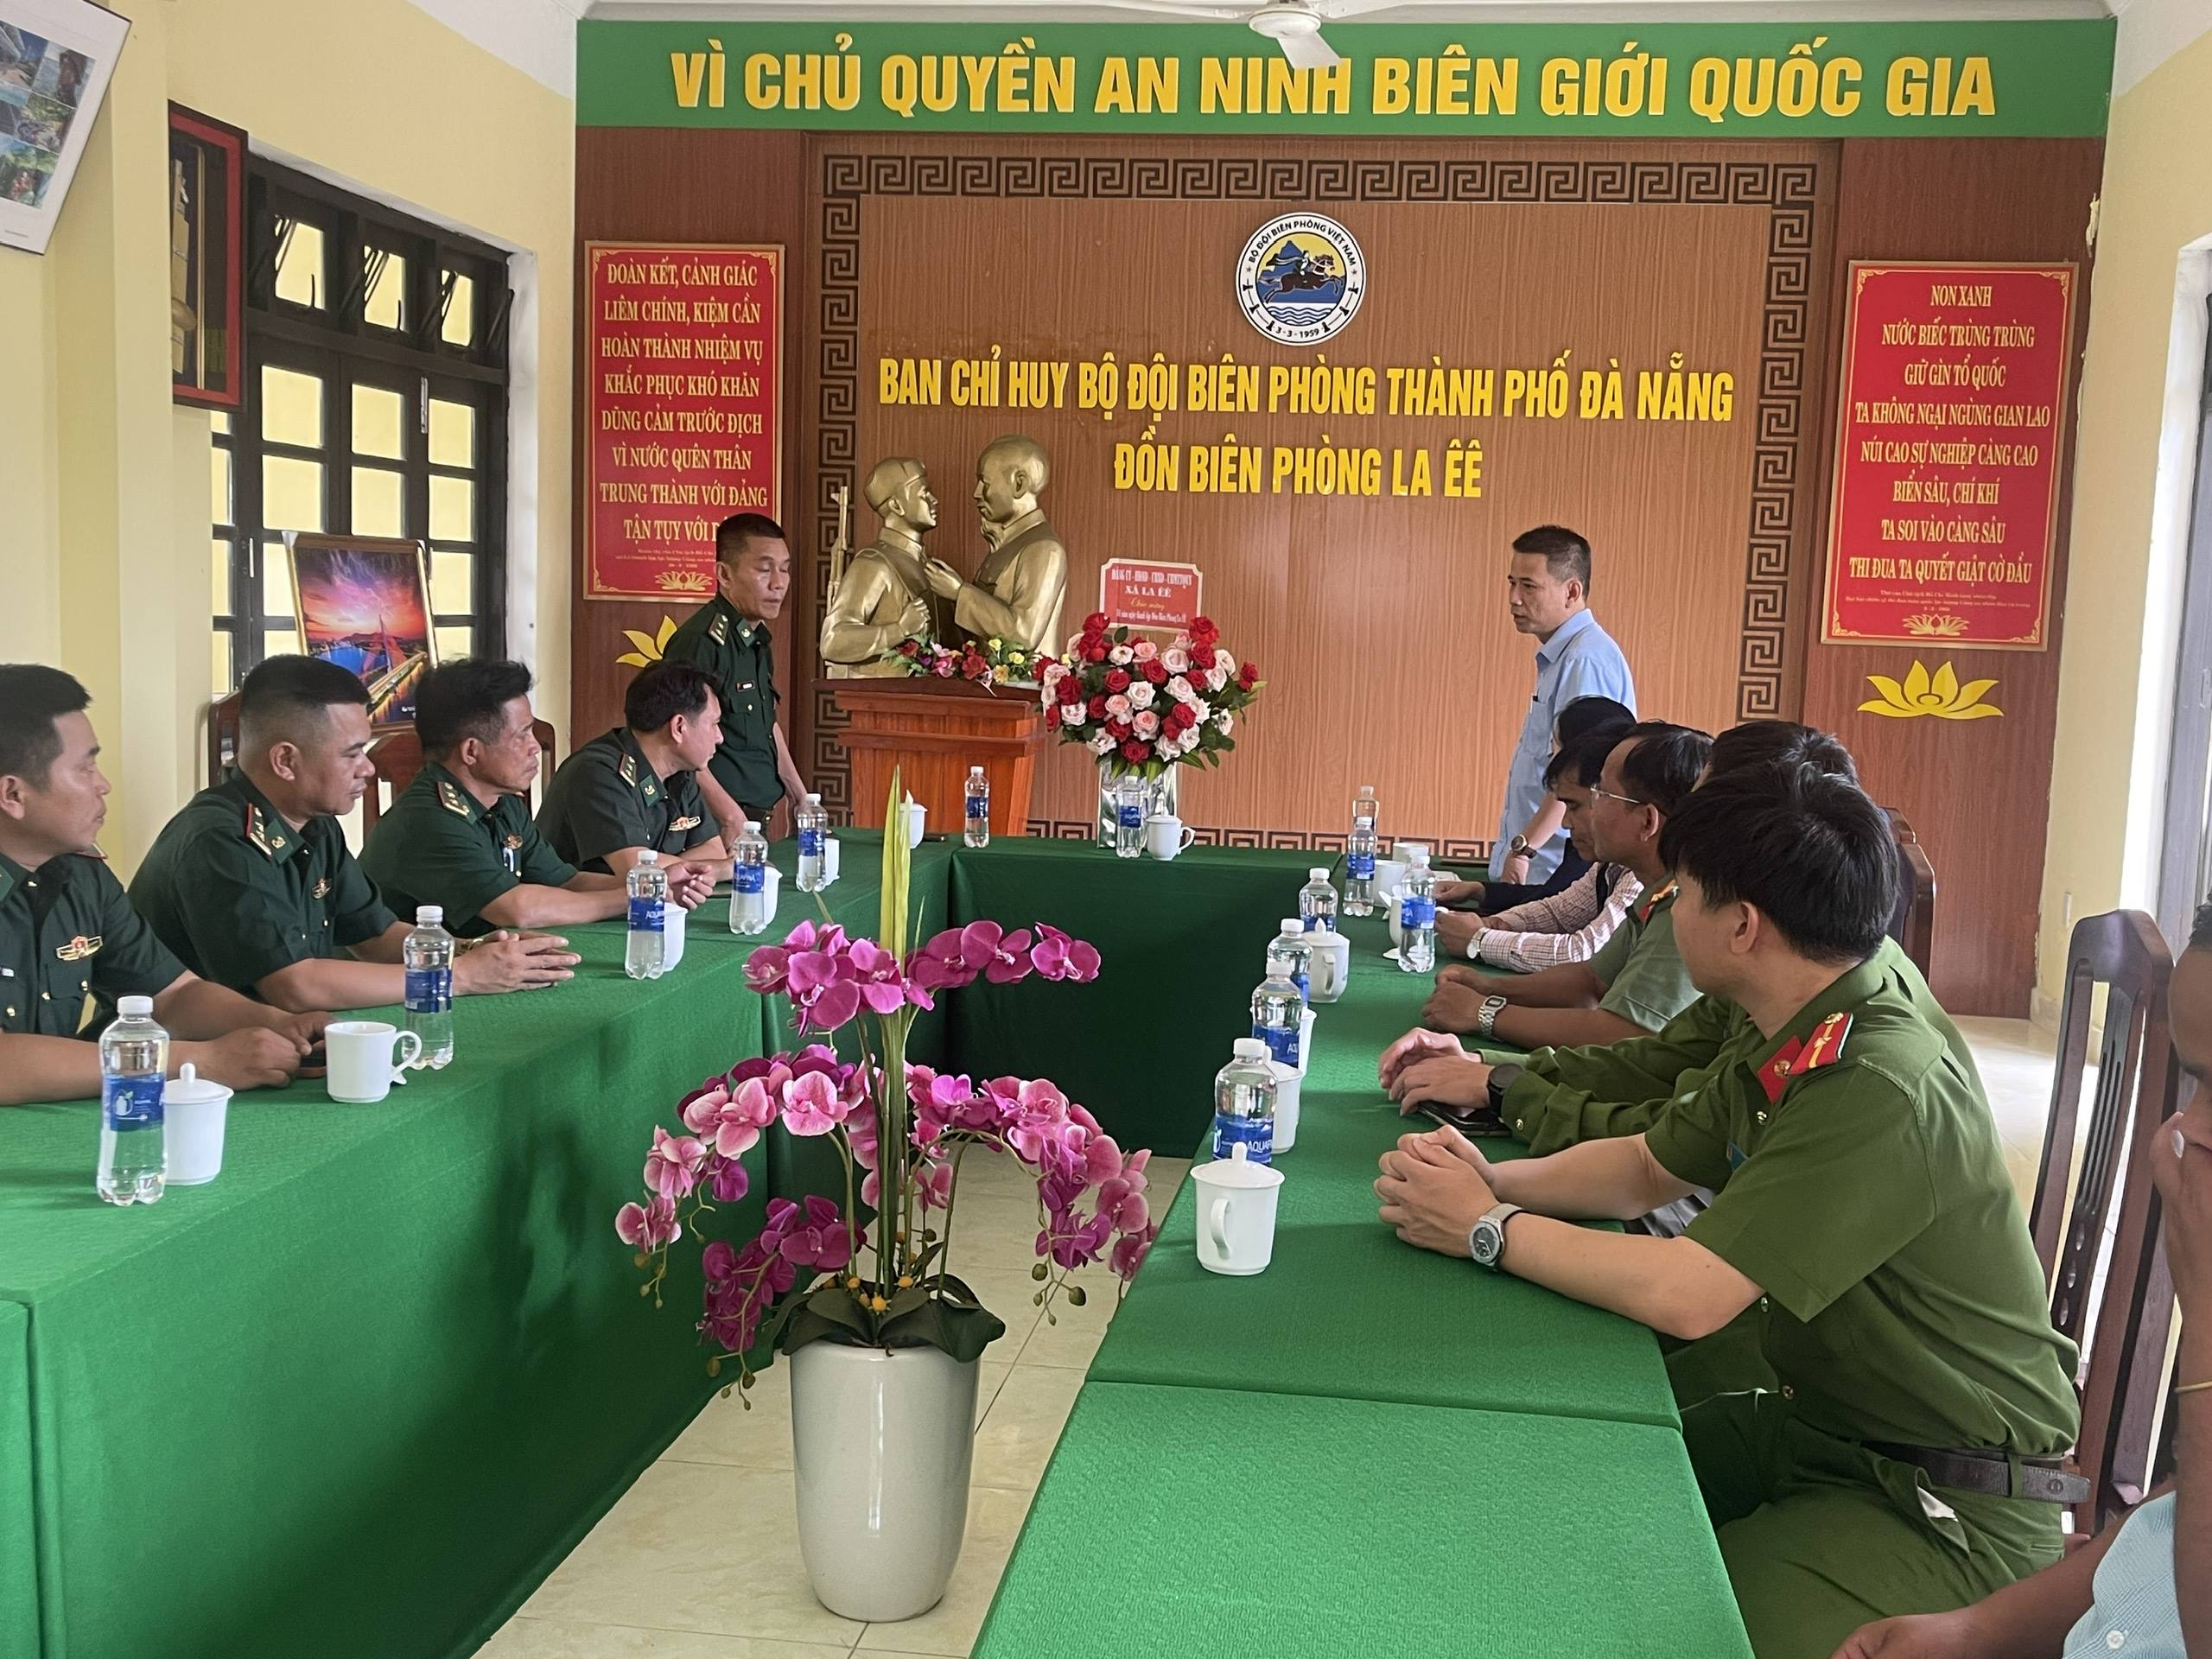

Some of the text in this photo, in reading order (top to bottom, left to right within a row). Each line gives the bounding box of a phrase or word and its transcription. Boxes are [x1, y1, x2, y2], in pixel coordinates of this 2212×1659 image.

[671, 34, 1996, 124] VÌ CHỦ QUYỀN AN NINH BIÊN GIỚI QUỐC GIA
[608, 256, 757, 288] ĐOÀN KẾT, CẢNH GIÁC
[605, 292, 760, 327] LIÊM CHÍNH, KIỆM CẦN
[1931, 285, 1992, 308] NON XANH
[601, 331, 763, 365] HOÀN THÀNH NHIỆM VỤ
[1882, 317, 2034, 347] NƯỚC BIẾC TRÙNG TRÙNG
[605, 365, 759, 400] KHẮC PHỤC KHÓ KHĂN
[880, 344, 1733, 422] BAN CHỈ HUY BỘ ĐỘI BIÊN PHÒNG THÀNH PHỐ ĐÀ NẴNG
[1929, 359, 1950, 385] GÌN
[1954, 354, 1971, 386] TỔ
[1972, 355, 2005, 390] QUỐC
[602, 404, 762, 439] DŨNG CẢM TRƯỚC ĐỊCH
[1855, 402, 1871, 423] TA
[1872, 397, 1914, 424] KHÔNG
[1916, 404, 1947, 431] NGẠI
[1994, 405, 2024, 426] GIAN
[2026, 406, 2050, 428] LAO
[613, 442, 751, 473] VÌ NƯỚC QUÊN THÂN
[1115, 425, 1482, 498] ĐỒN BIÊN PHÒNG LA ÊÊ
[1861, 435, 2037, 469] NÚI CAO SỰ NGHIỆP CÀNG CAO
[600, 478, 767, 506] TRUNG THÀNH VỚI ĐẢNG
[1893, 469, 1999, 506] BIỂN SÂU, CHÍ KHÍ
[624, 512, 652, 544] TẬN
[655, 520, 681, 548] TỤY
[684, 516, 709, 541] VỚI
[1881, 515, 2005, 543] TA SOI VÀO CÀNG SÂU
[1850, 550, 2031, 587] THI ĐUA TA QUYẾT GIẬT CỜ ĐẦU
